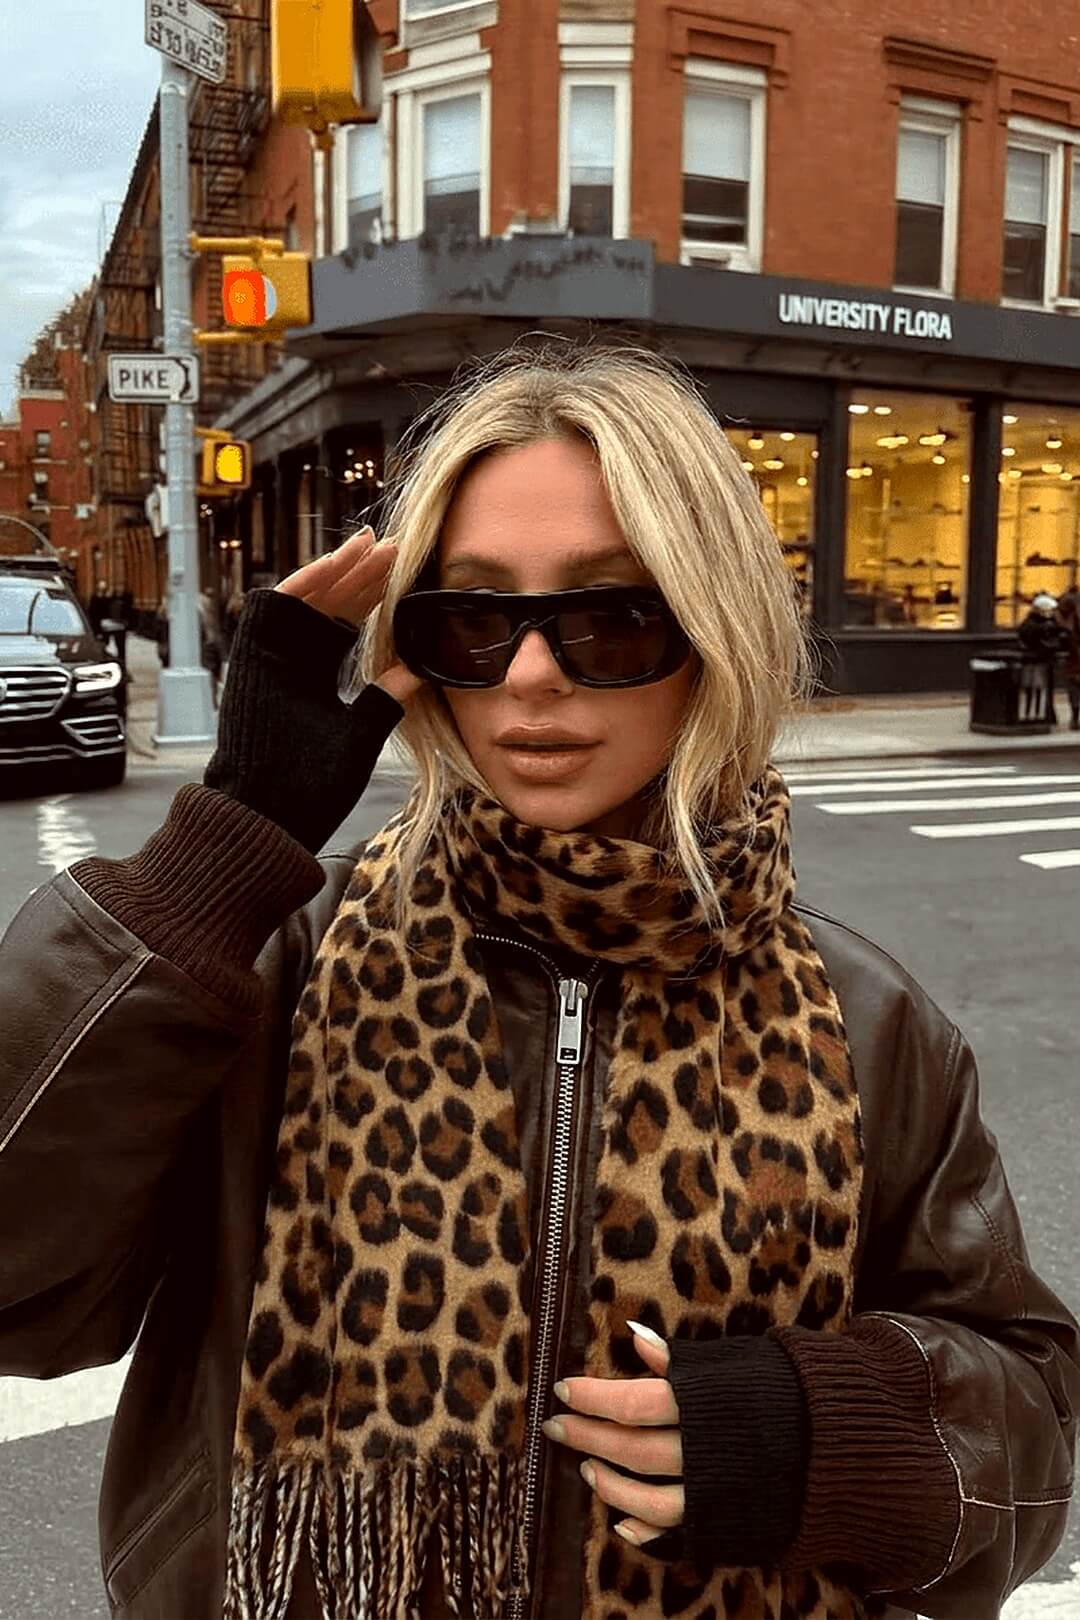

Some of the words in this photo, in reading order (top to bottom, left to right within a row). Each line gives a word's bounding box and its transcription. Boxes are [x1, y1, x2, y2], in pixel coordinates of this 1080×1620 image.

[779, 293, 891, 332] UNIVERSITY
[893, 307, 952, 340] FLORA
[119, 369, 171, 389] PIKE
